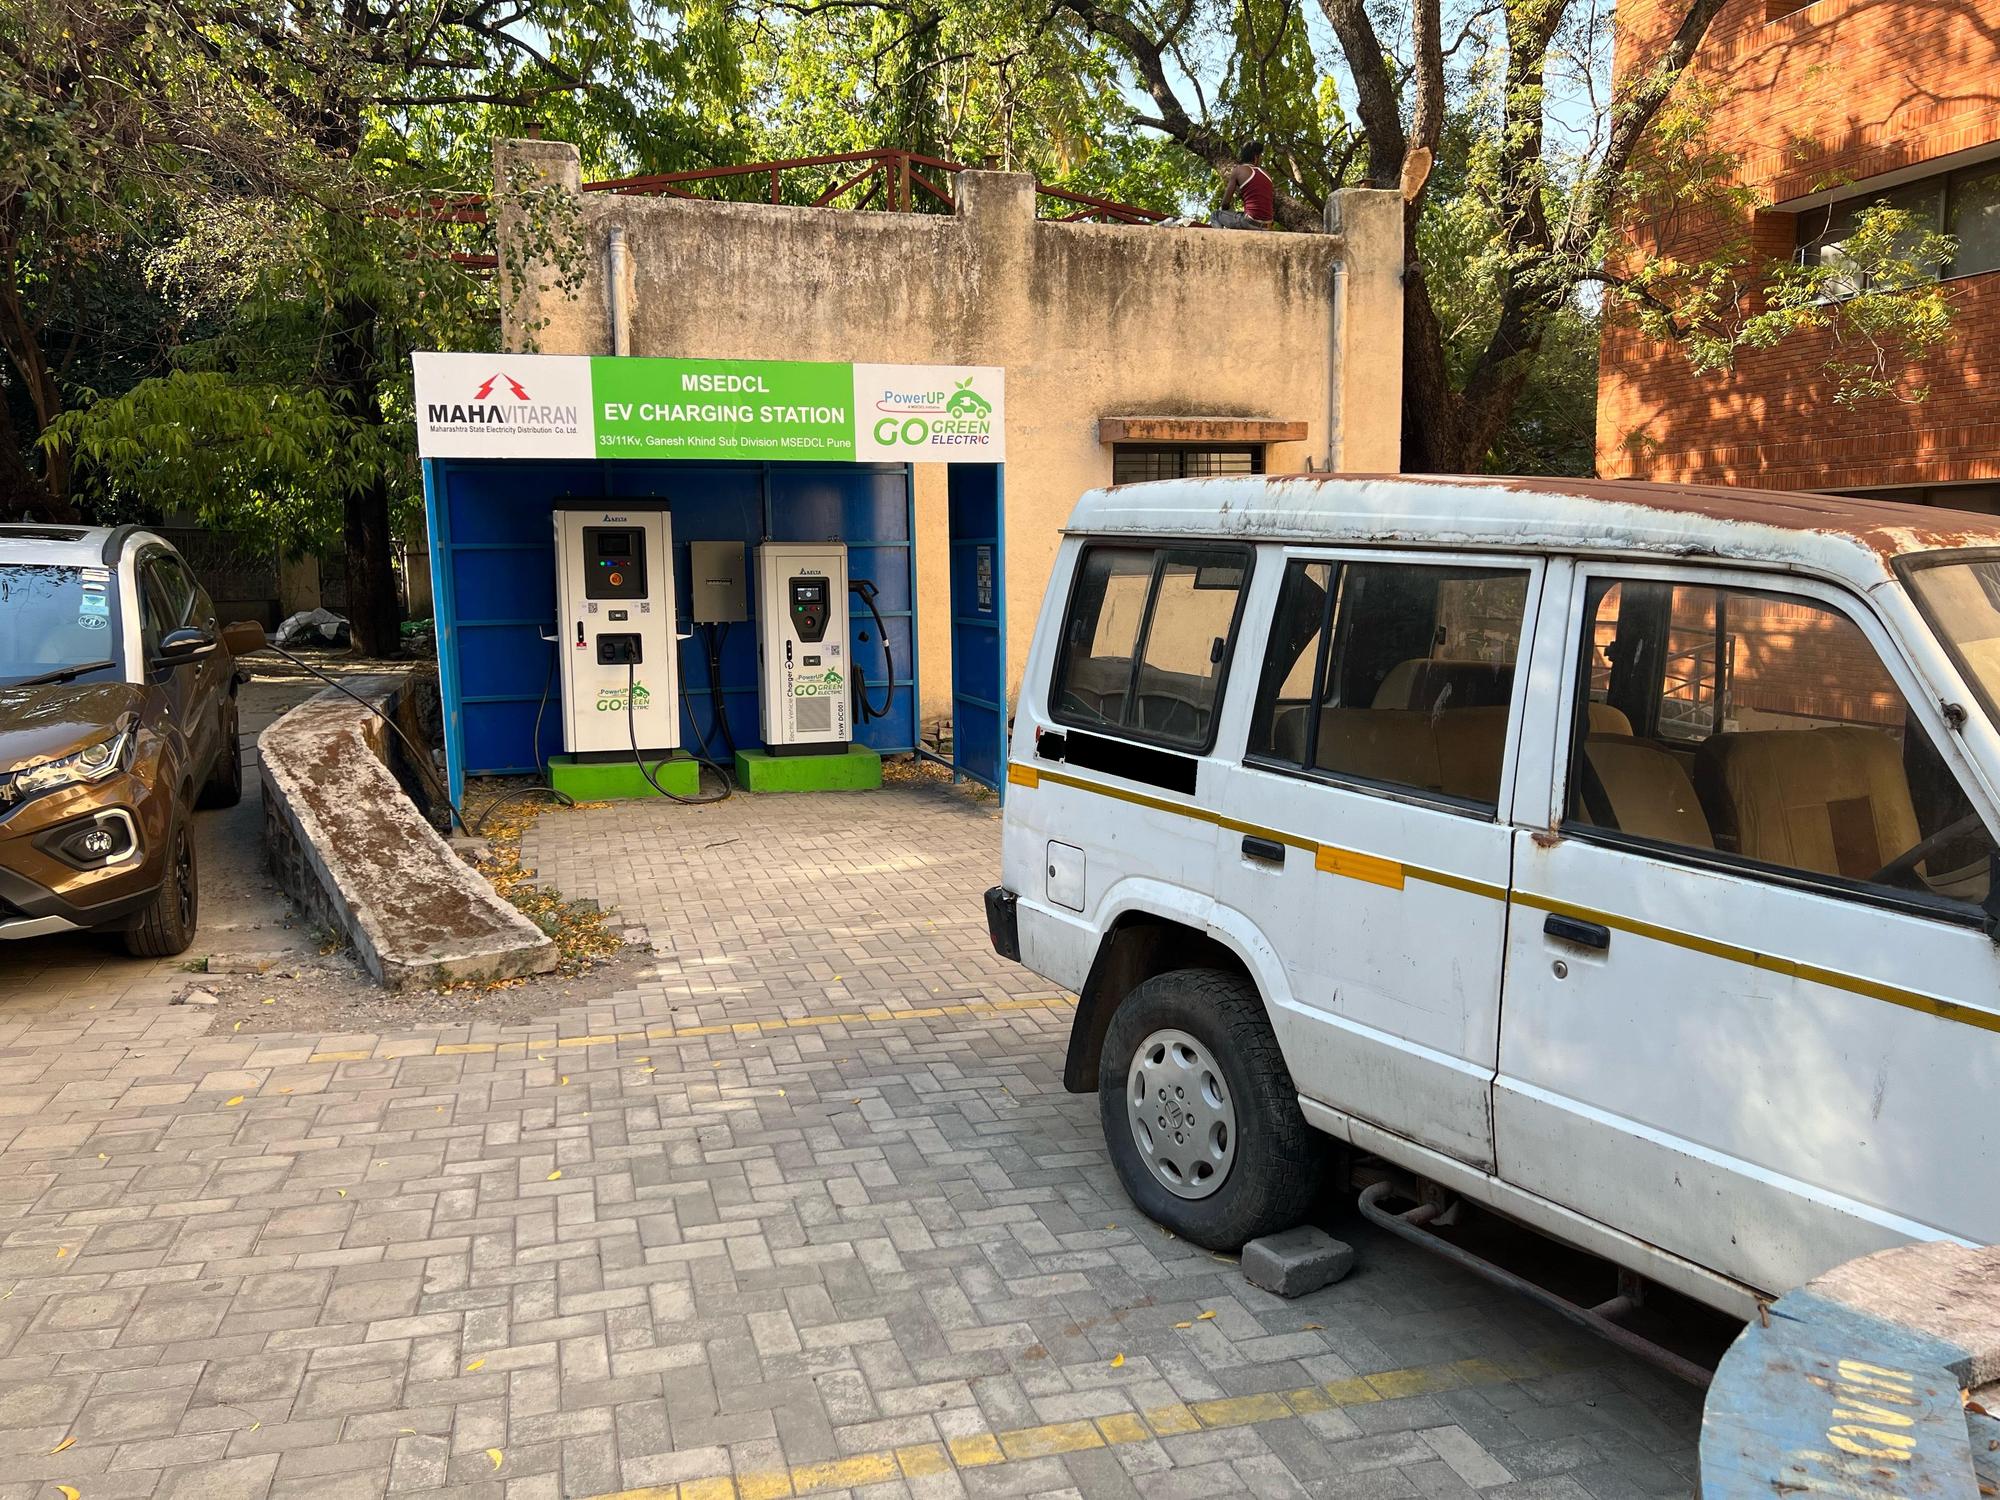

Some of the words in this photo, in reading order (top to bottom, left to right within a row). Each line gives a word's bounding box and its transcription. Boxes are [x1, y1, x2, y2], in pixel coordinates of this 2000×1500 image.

[682, 374, 769, 393] MSEDCL
[884, 390, 945, 404] PowerUP
[428, 404, 577, 424] MAHAVITARAN
[604, 403, 633, 421] EV
[640, 404, 754, 423] CHARGING
[760, 406, 845, 424] STATION
[430, 425, 468, 433] Maharashtra
[470, 425, 485, 433] State
[486, 425, 516, 435] Electricity
[518, 426, 552, 434] Distribution
[566, 426, 578, 434] Ltd.
[873, 417, 929, 446] GO
[931, 420, 990, 434] GREEN
[600, 435, 643, 447] 33/11Kv,
[645, 436, 685, 446] Ganesh
[688, 436, 716, 446] Khind
[719, 437, 738, 446] Sub
[741, 437, 778, 447] Division
[781, 438, 824, 448] MSEDCL
[827, 438, 851, 448] Pune
[931, 435, 990, 445] ELECTRIC
[795, 685, 817, 696] GO
[597, 700, 621, 711] GO
